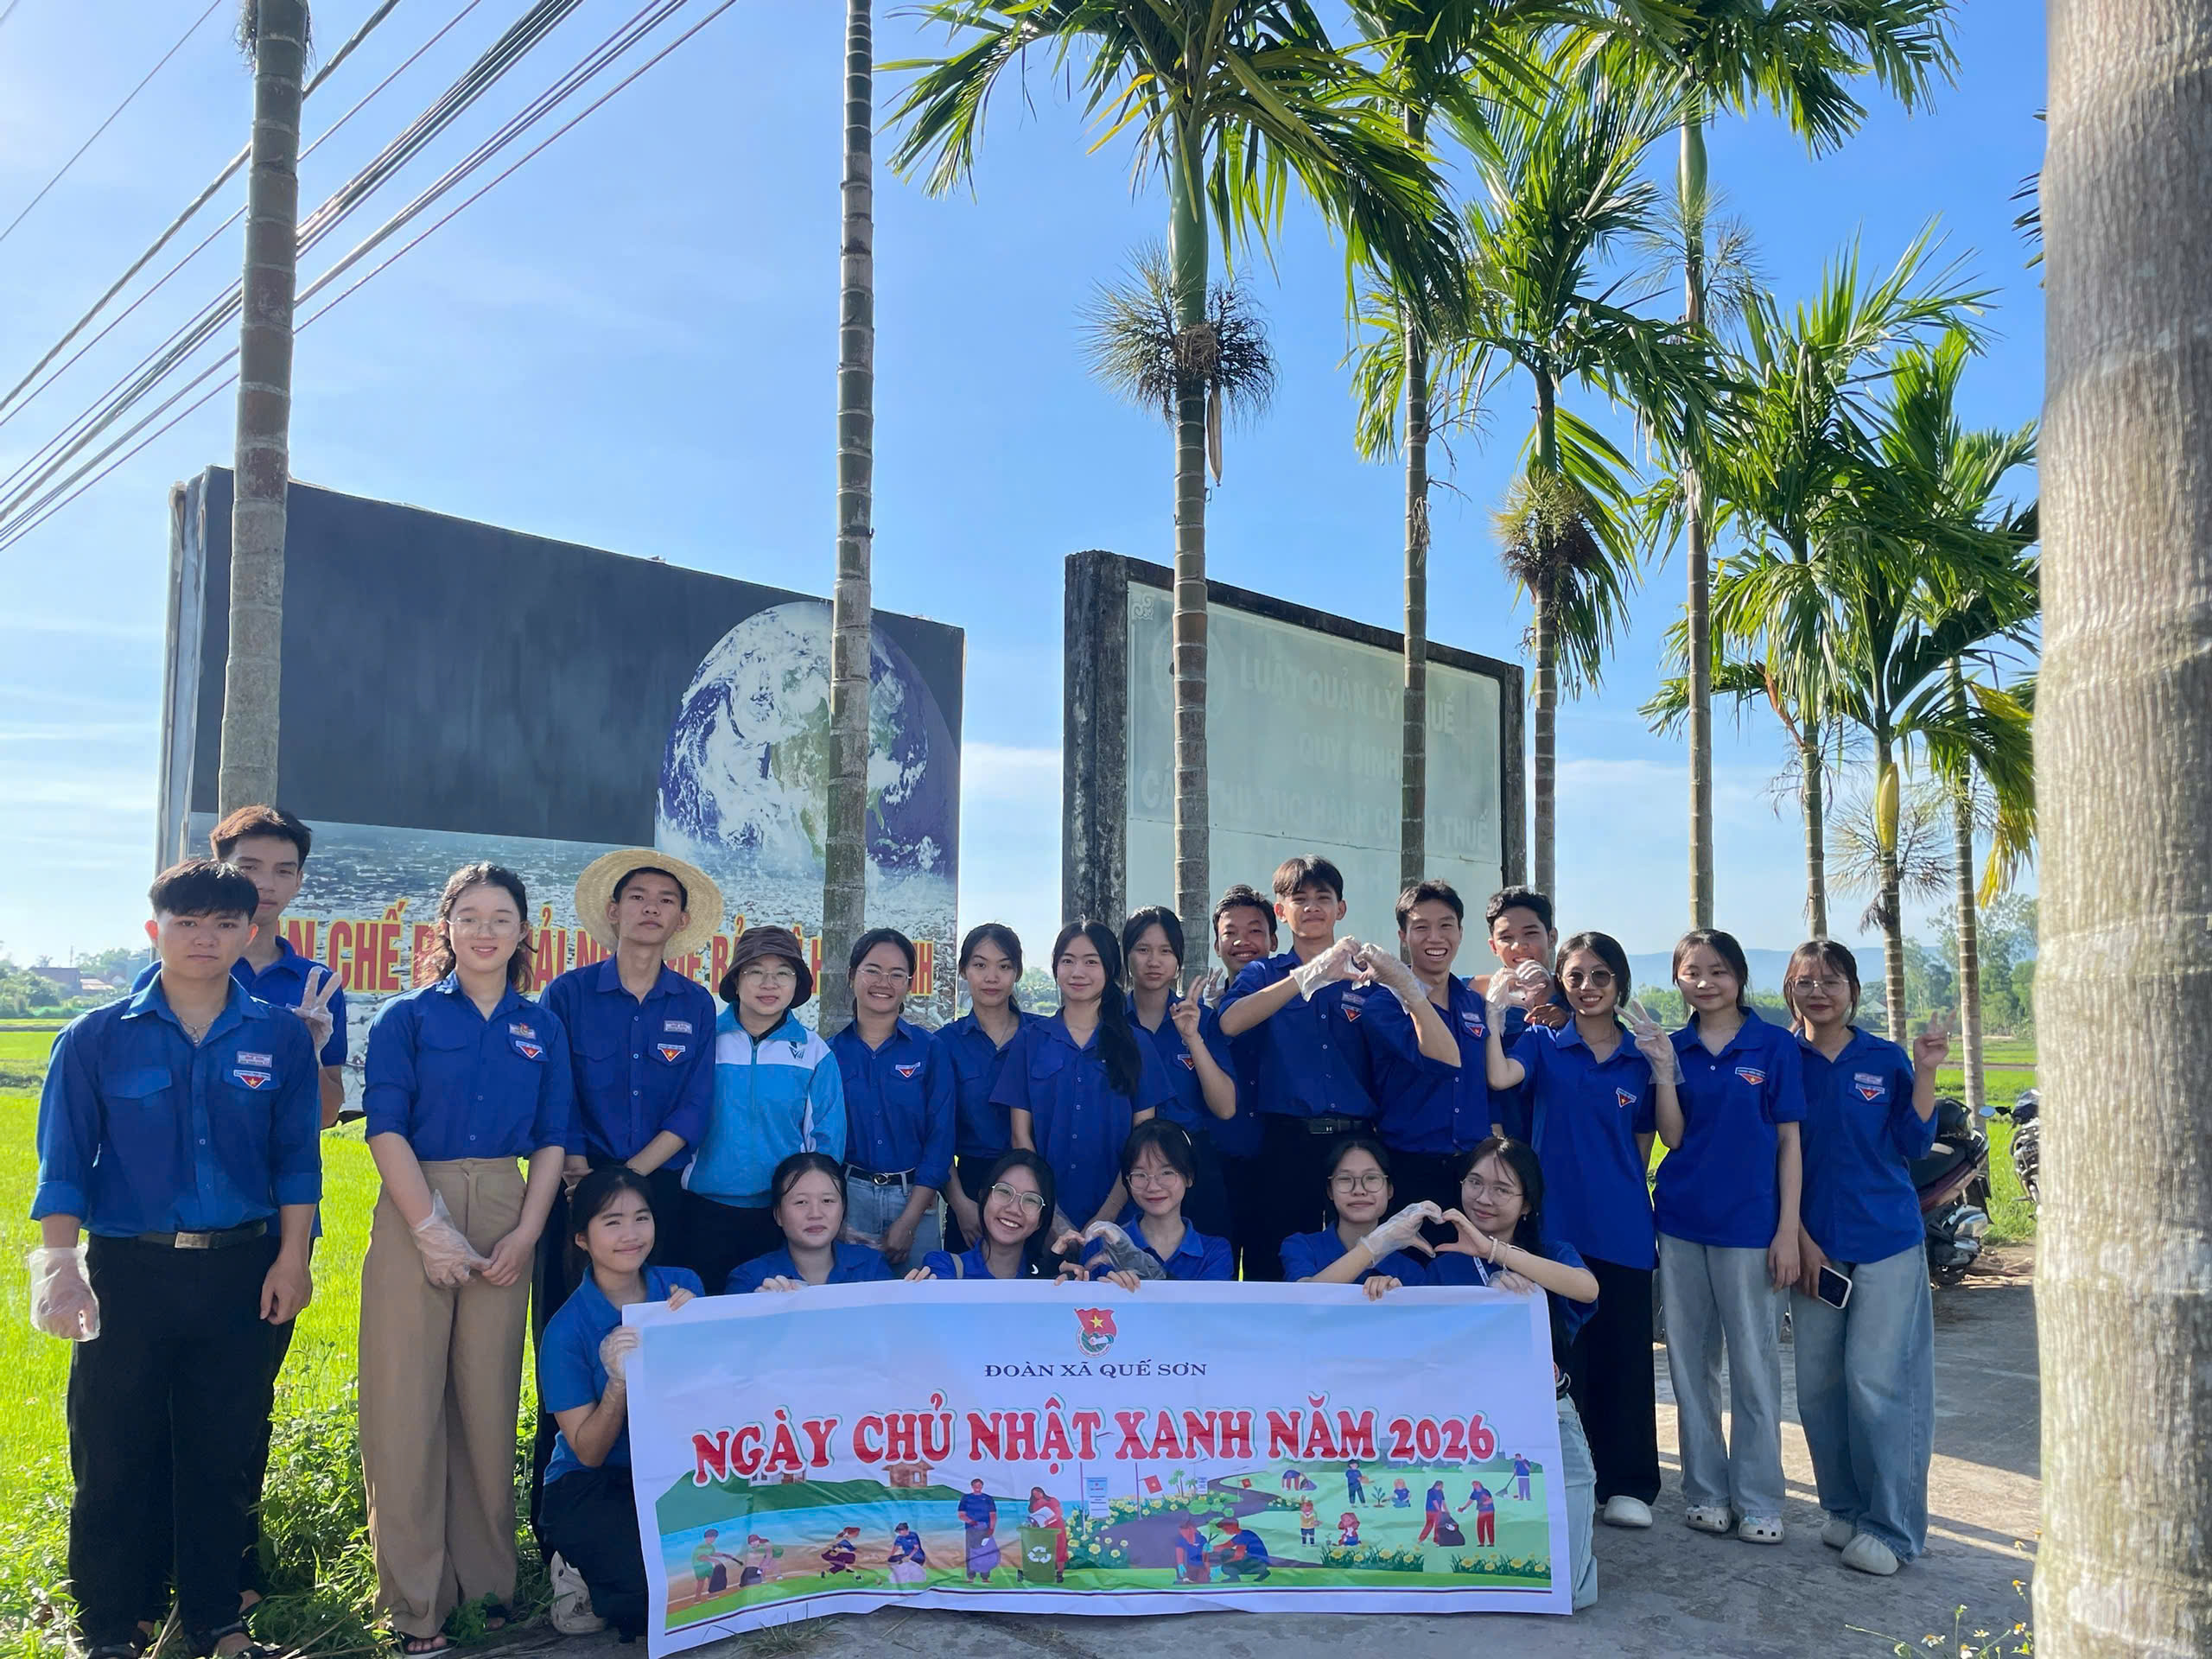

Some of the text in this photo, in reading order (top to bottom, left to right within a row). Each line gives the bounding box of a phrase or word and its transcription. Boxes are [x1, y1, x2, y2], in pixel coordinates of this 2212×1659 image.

[1307, 666, 1368, 716] QUẢN
[1374, 681, 1398, 721] LÝ
[327, 900, 403, 992] CHẾ
[984, 1358, 1208, 1379] ĐOÀN XÃ QUẾ SƠN
[690, 1391, 1496, 1485] NGÀY CHỦ NHẬT XANH NĂM 2026
